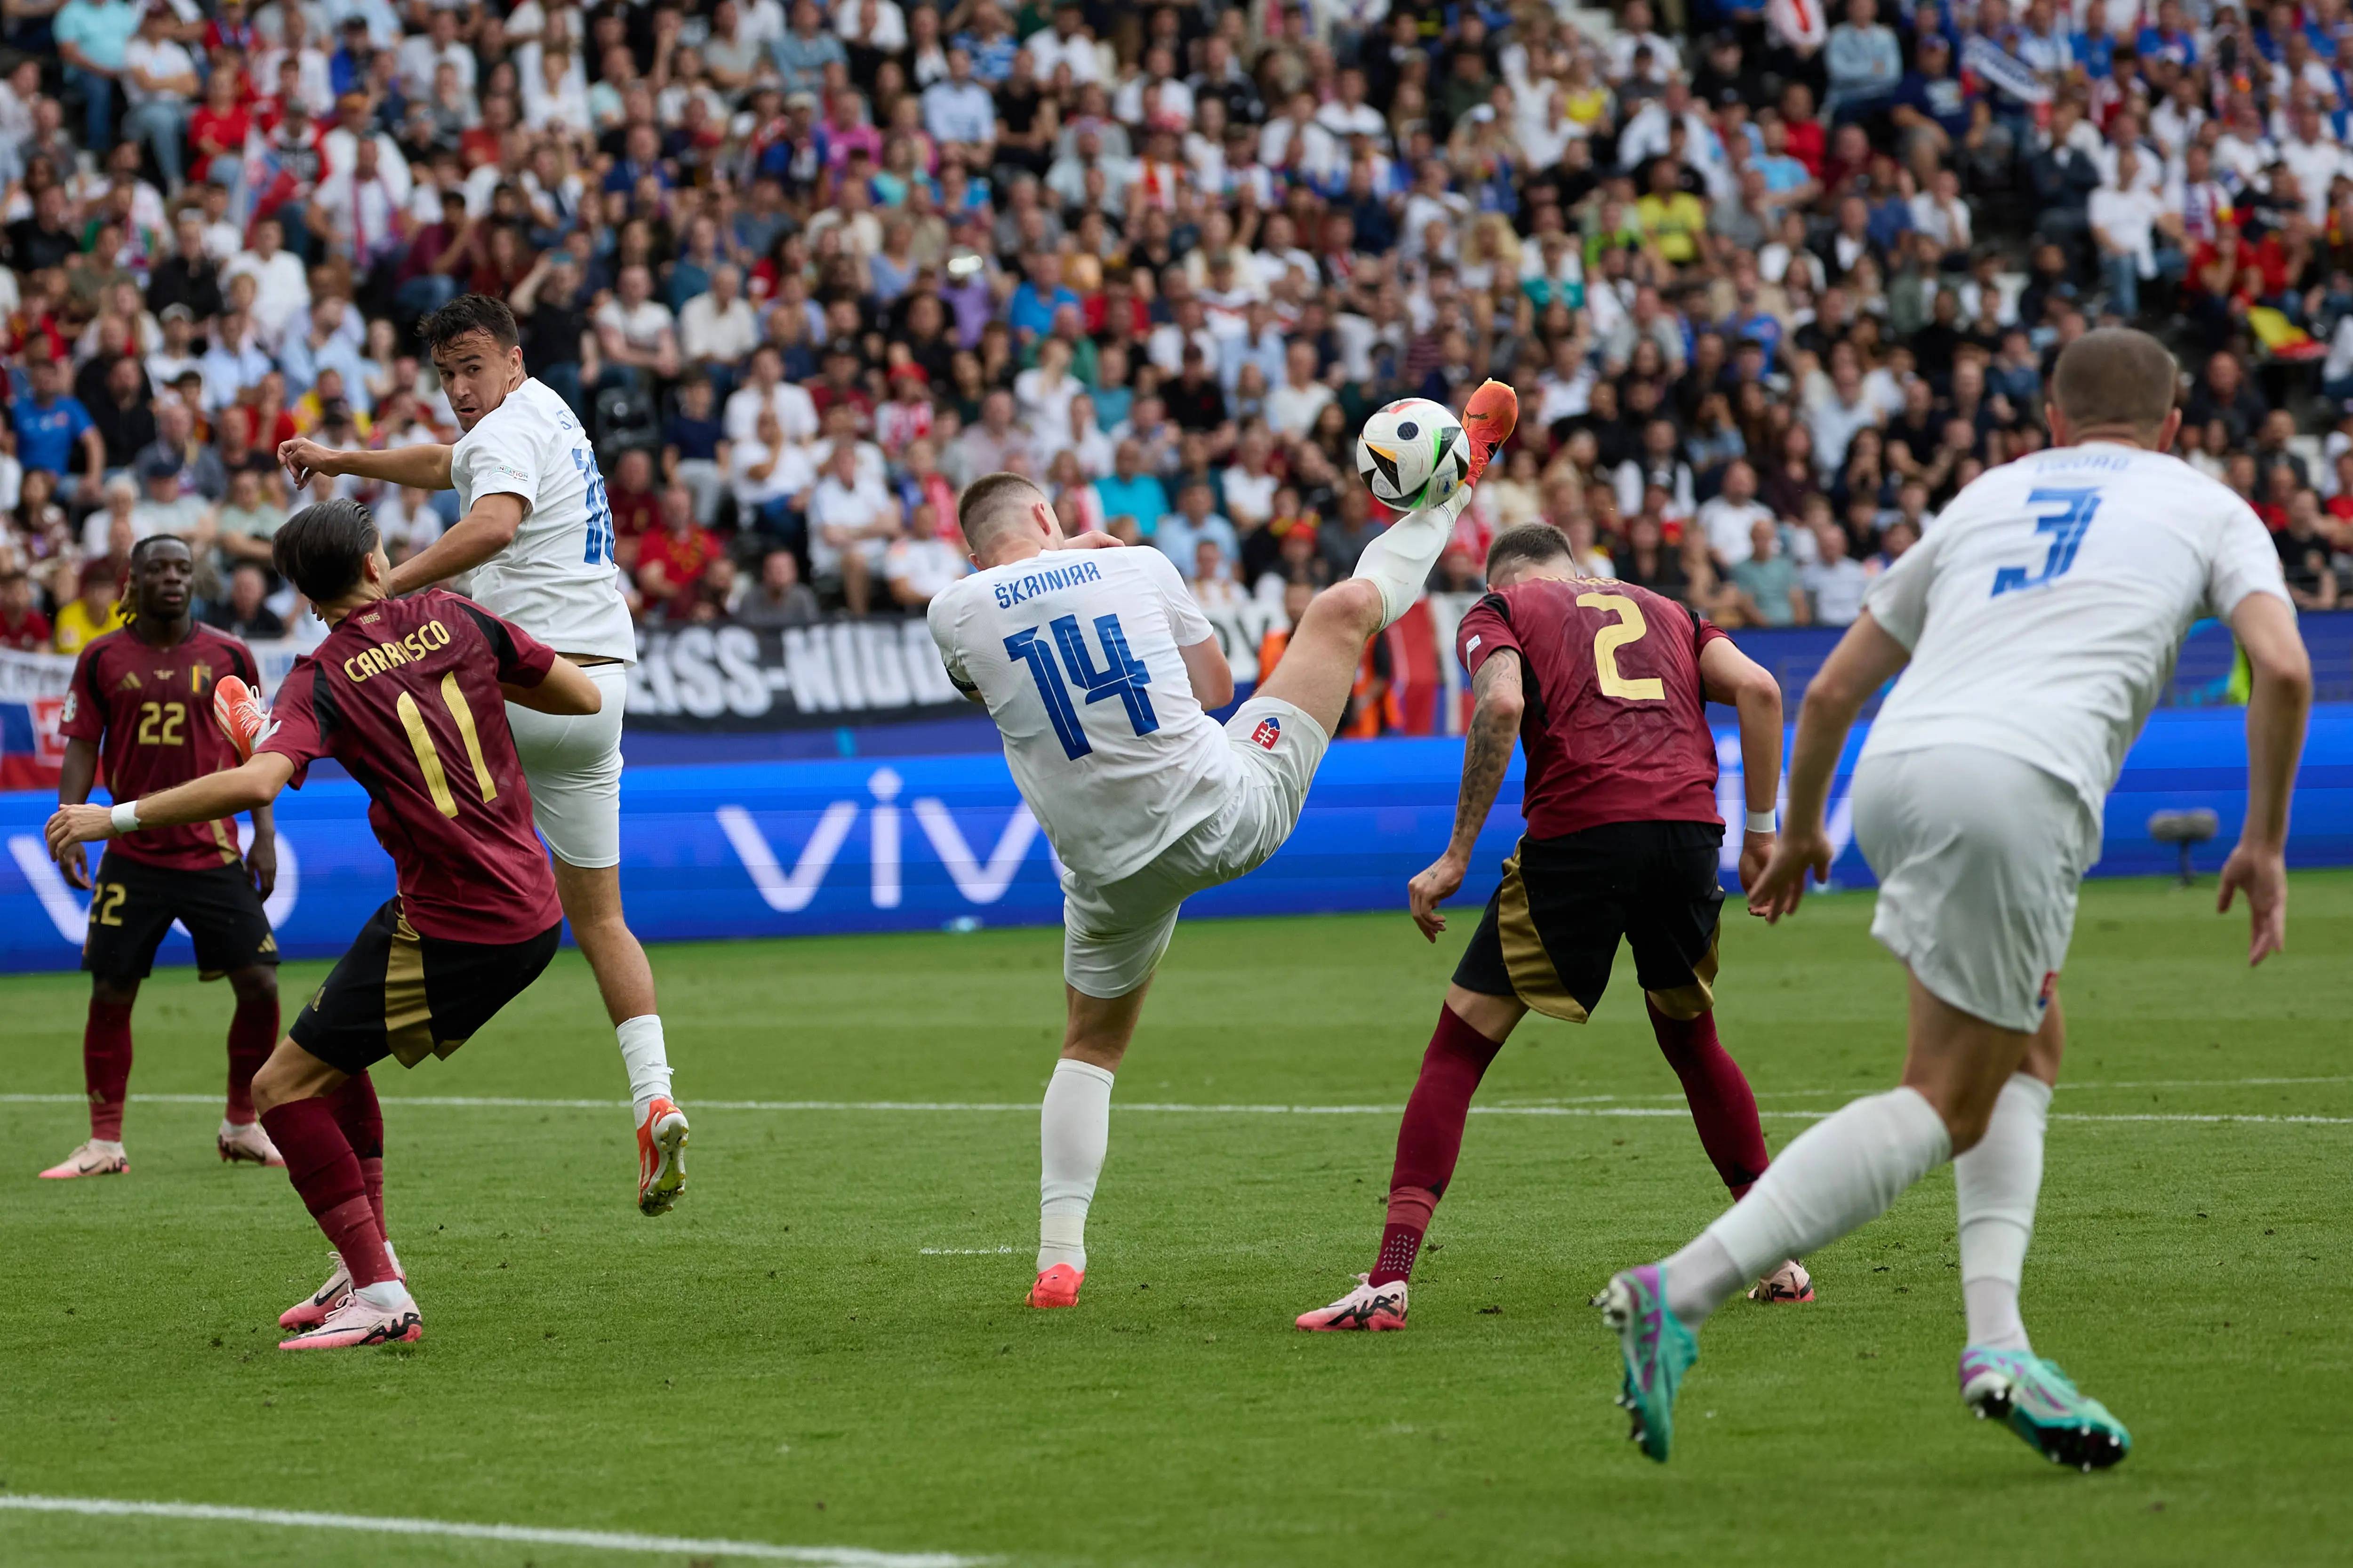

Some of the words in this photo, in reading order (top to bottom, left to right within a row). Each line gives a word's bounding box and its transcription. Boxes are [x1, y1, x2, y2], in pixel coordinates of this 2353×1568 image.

[994, 561, 1101, 609] ŠKRINIAR
[1991, 486, 2103, 598] 3
[344, 620, 450, 682] CARRASCO
[360, 612, 380, 625] 1895
[1576, 592, 1665, 700] 2
[139, 702, 185, 745] 22
[1002, 614, 1160, 761] 14
[397, 671, 498, 818] 11
[715, 767, 1064, 912] viv
